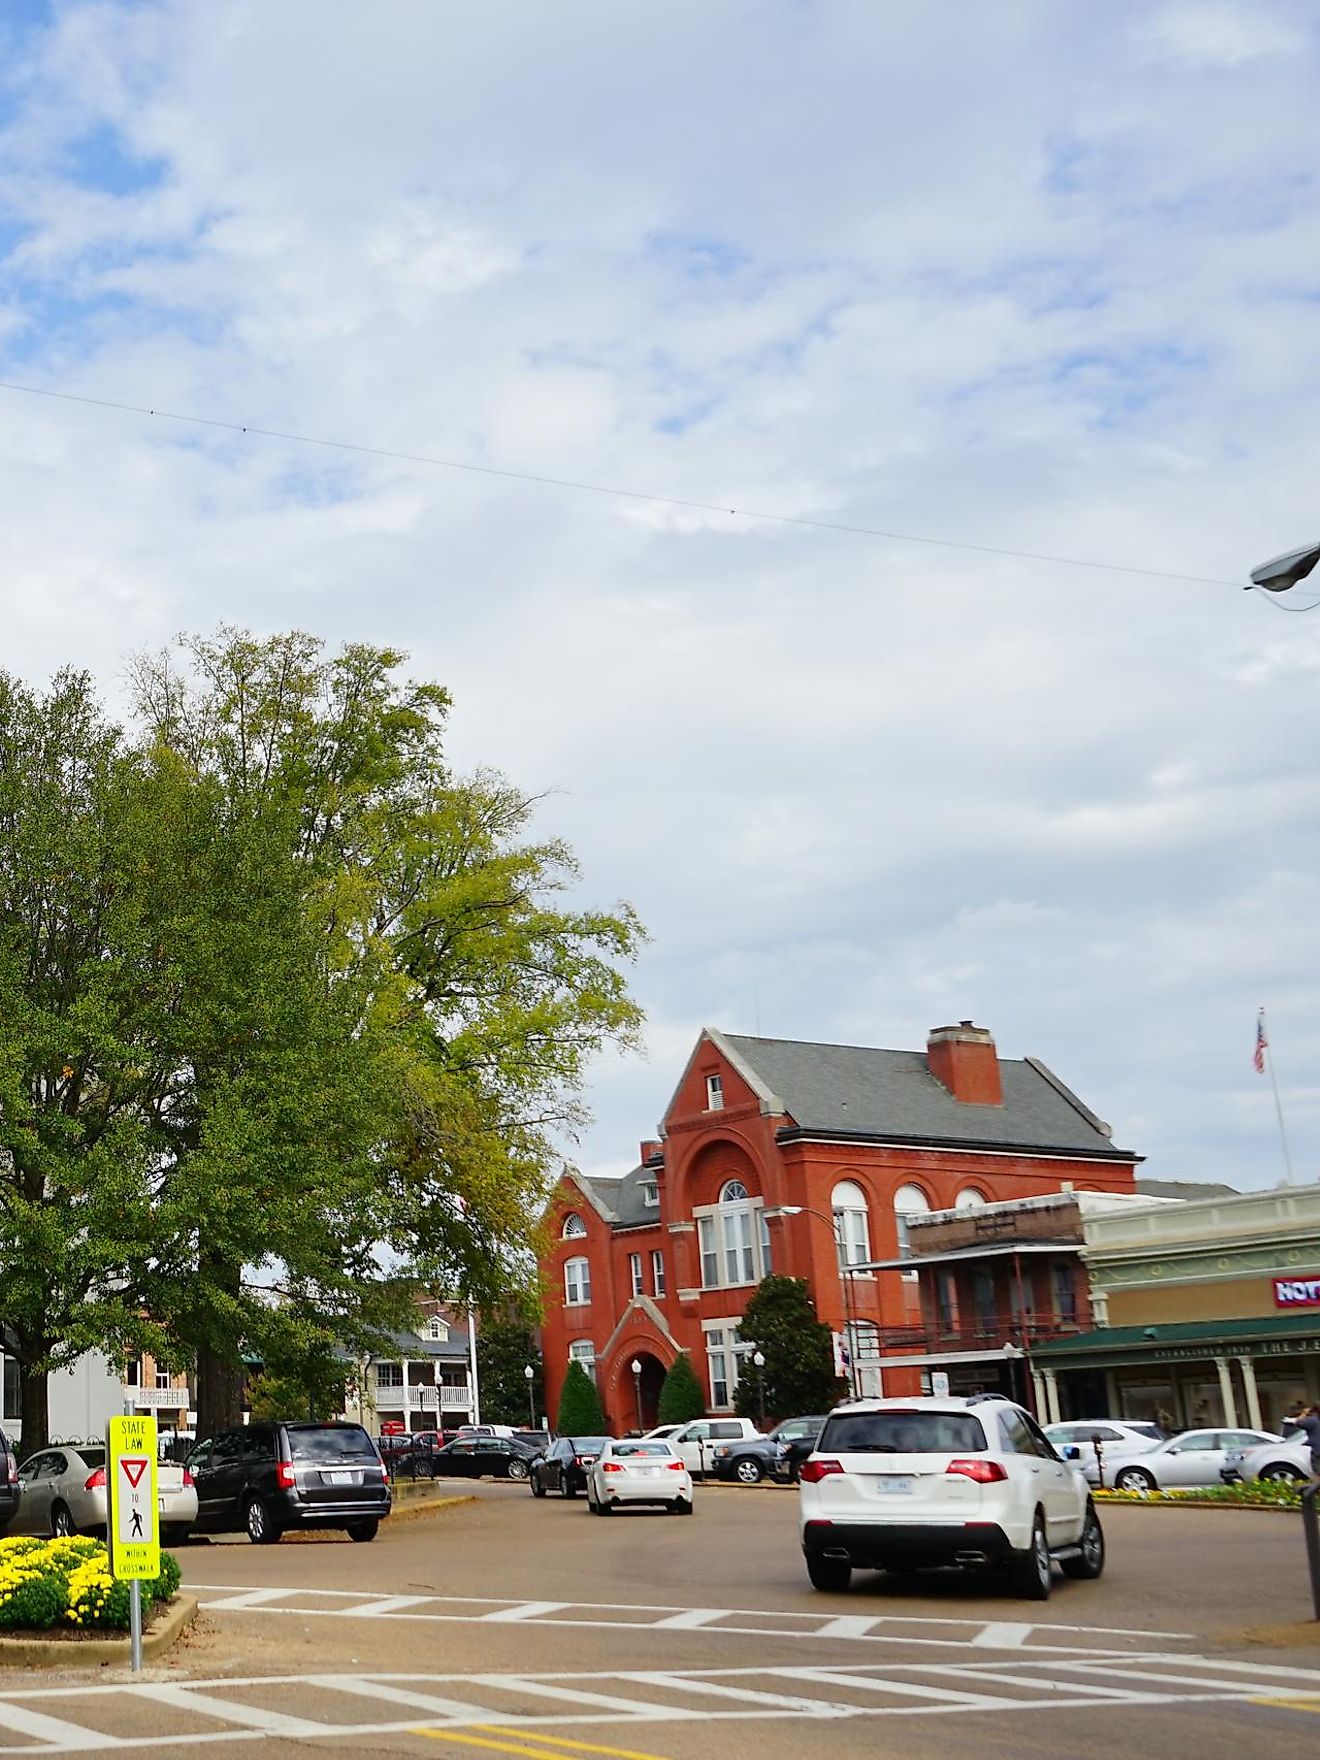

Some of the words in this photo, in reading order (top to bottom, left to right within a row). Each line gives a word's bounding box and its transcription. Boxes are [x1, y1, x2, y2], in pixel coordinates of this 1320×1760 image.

[1262, 1342, 1290, 1353] THE
[121, 1420, 146, 1434] STATE
[125, 1437, 143, 1450] LAW
[131, 1494, 139, 1504] TO
